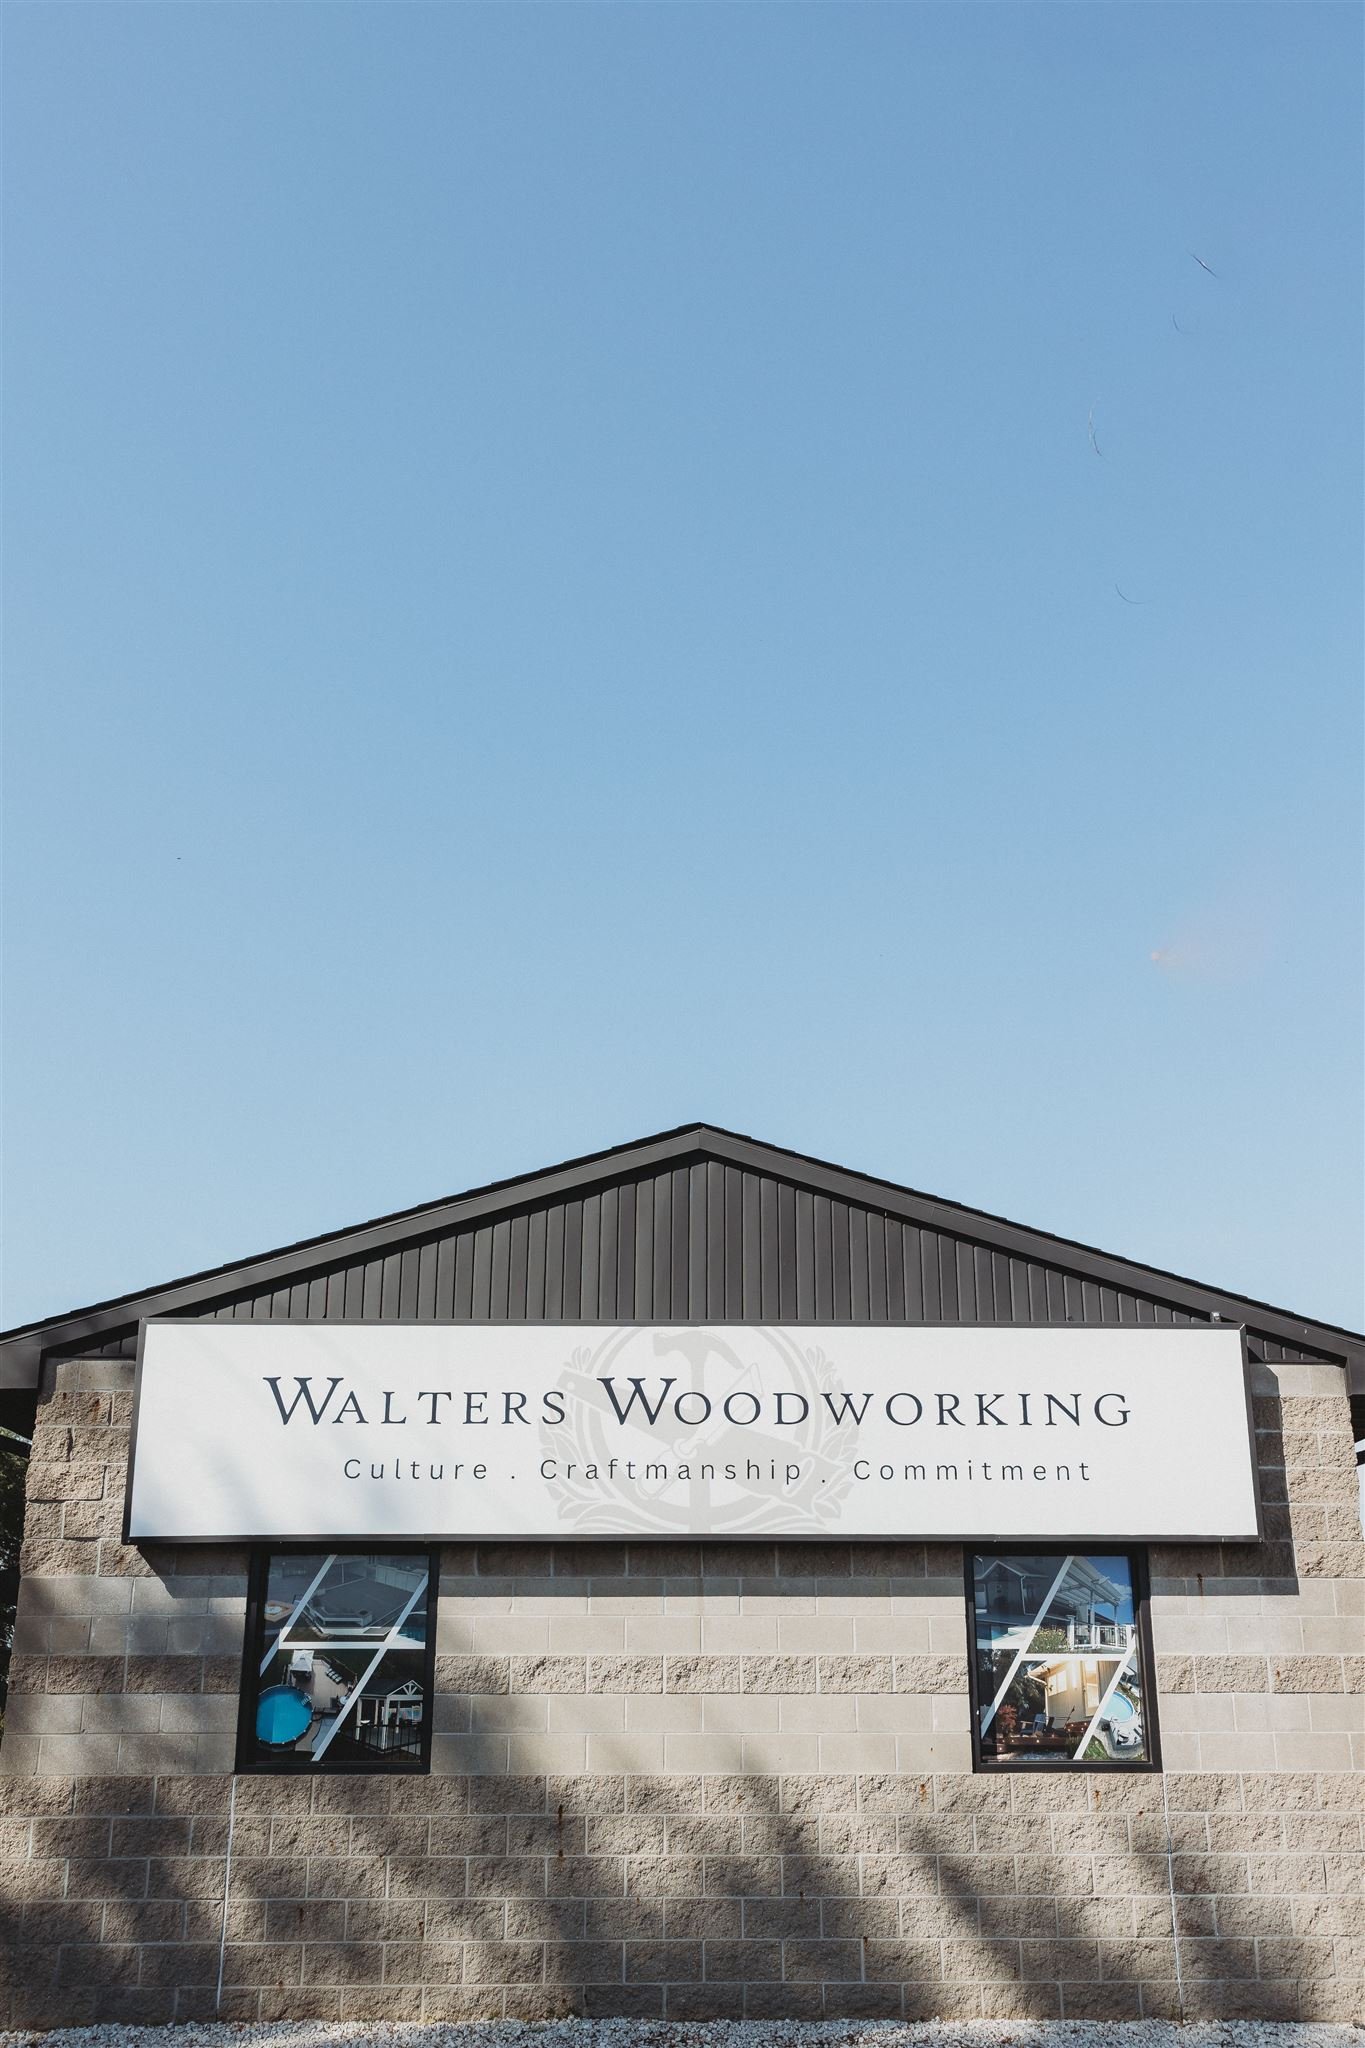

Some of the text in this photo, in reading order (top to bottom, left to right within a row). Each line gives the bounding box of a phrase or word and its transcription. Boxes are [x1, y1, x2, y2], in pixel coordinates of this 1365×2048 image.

[262, 1376, 1132, 1427] WALTERS WOODWORKING
[343, 1458, 488, 1480] Culture
[540, 1458, 801, 1486] Craftmanship
[853, 1459, 1091, 1482] Commitment
